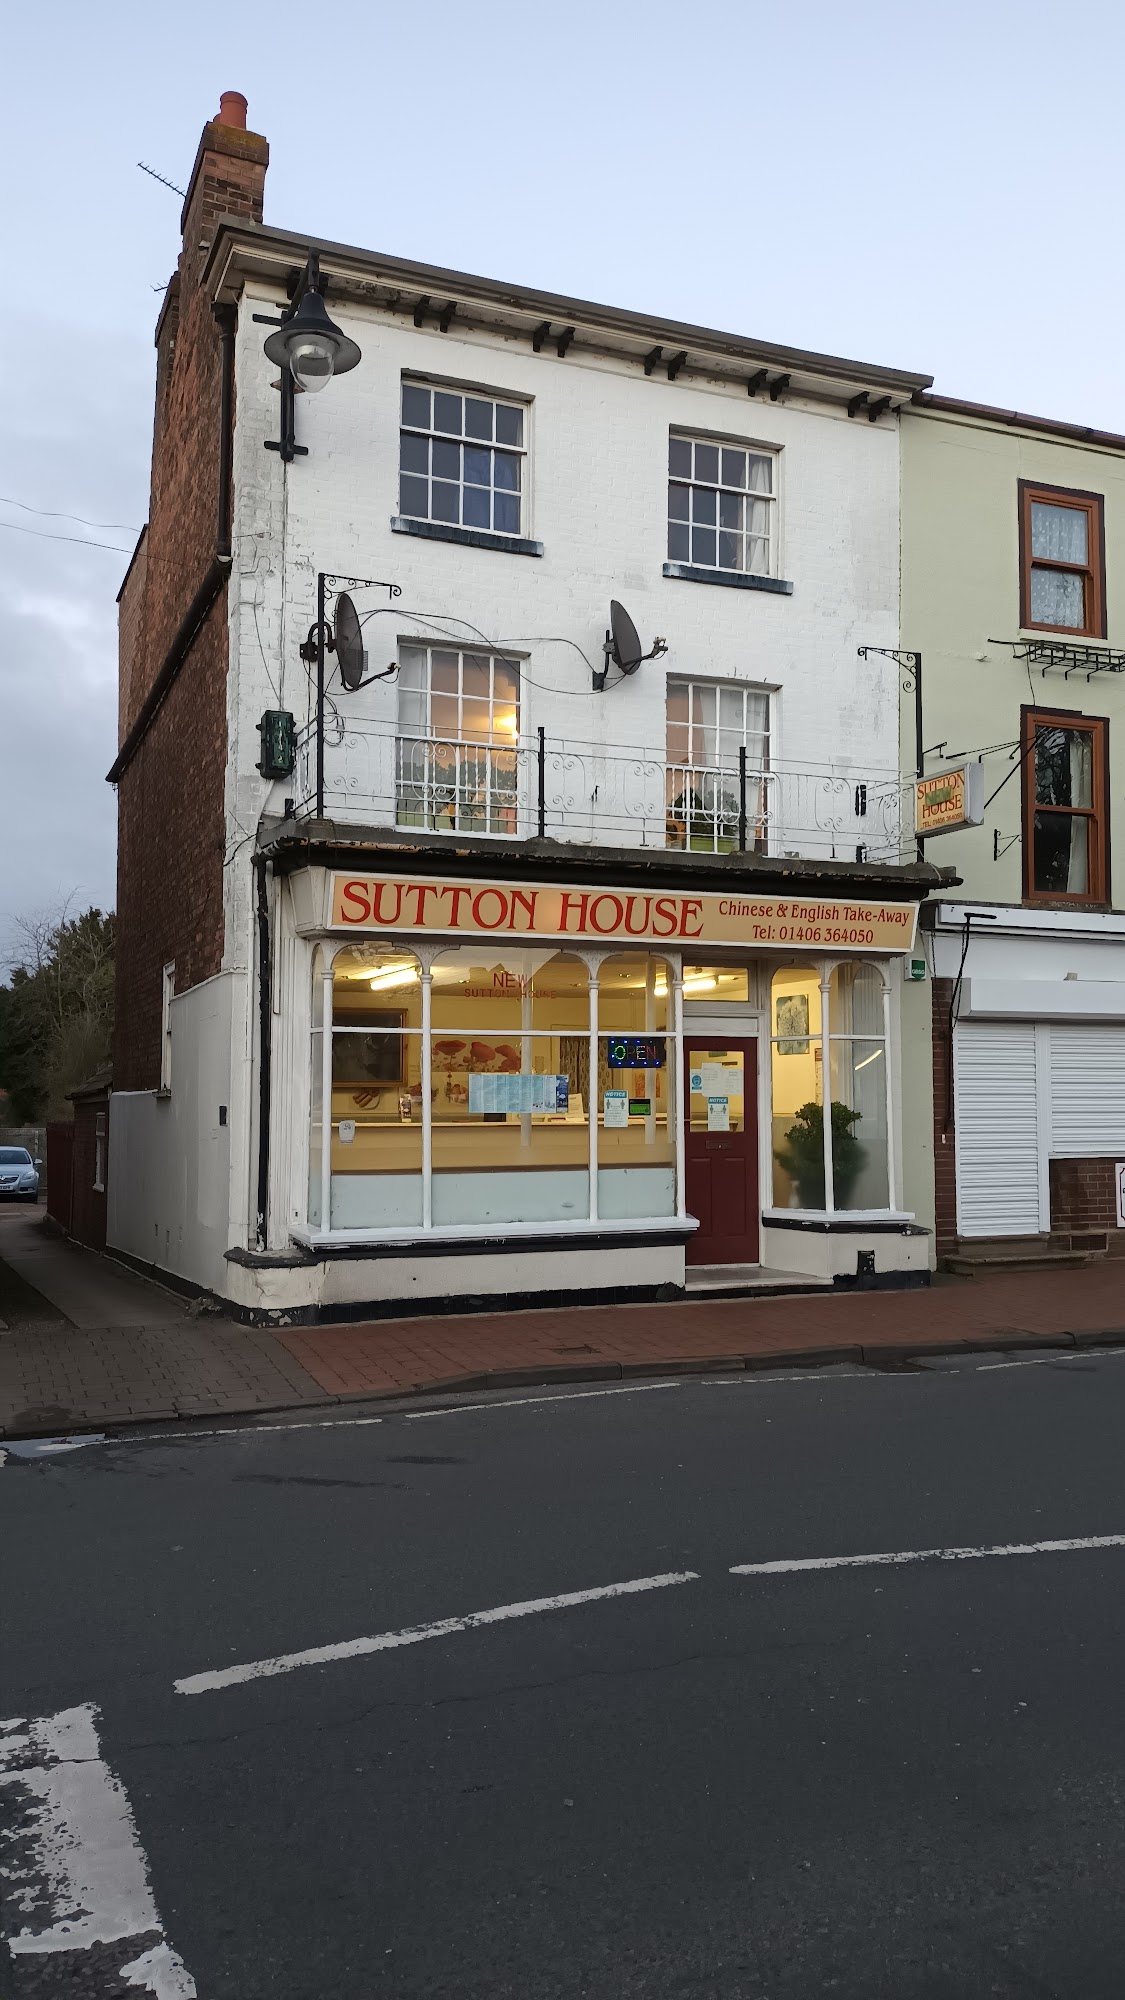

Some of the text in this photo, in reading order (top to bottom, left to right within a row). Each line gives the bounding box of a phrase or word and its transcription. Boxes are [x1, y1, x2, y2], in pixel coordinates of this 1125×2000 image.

[918, 774, 965, 800] SUTTON
[922, 794, 963, 819] HOUSE
[341, 881, 704, 937] SUTTON HOUSE
[719, 901, 910, 927] Chinese & English Take-Away
[752, 925, 874, 944] Tel: 01406 364050
[493, 972, 528, 988] NEW
[464, 988, 558, 999] SUTTON HOUSE
[614, 1045, 657, 1060] OPEN
